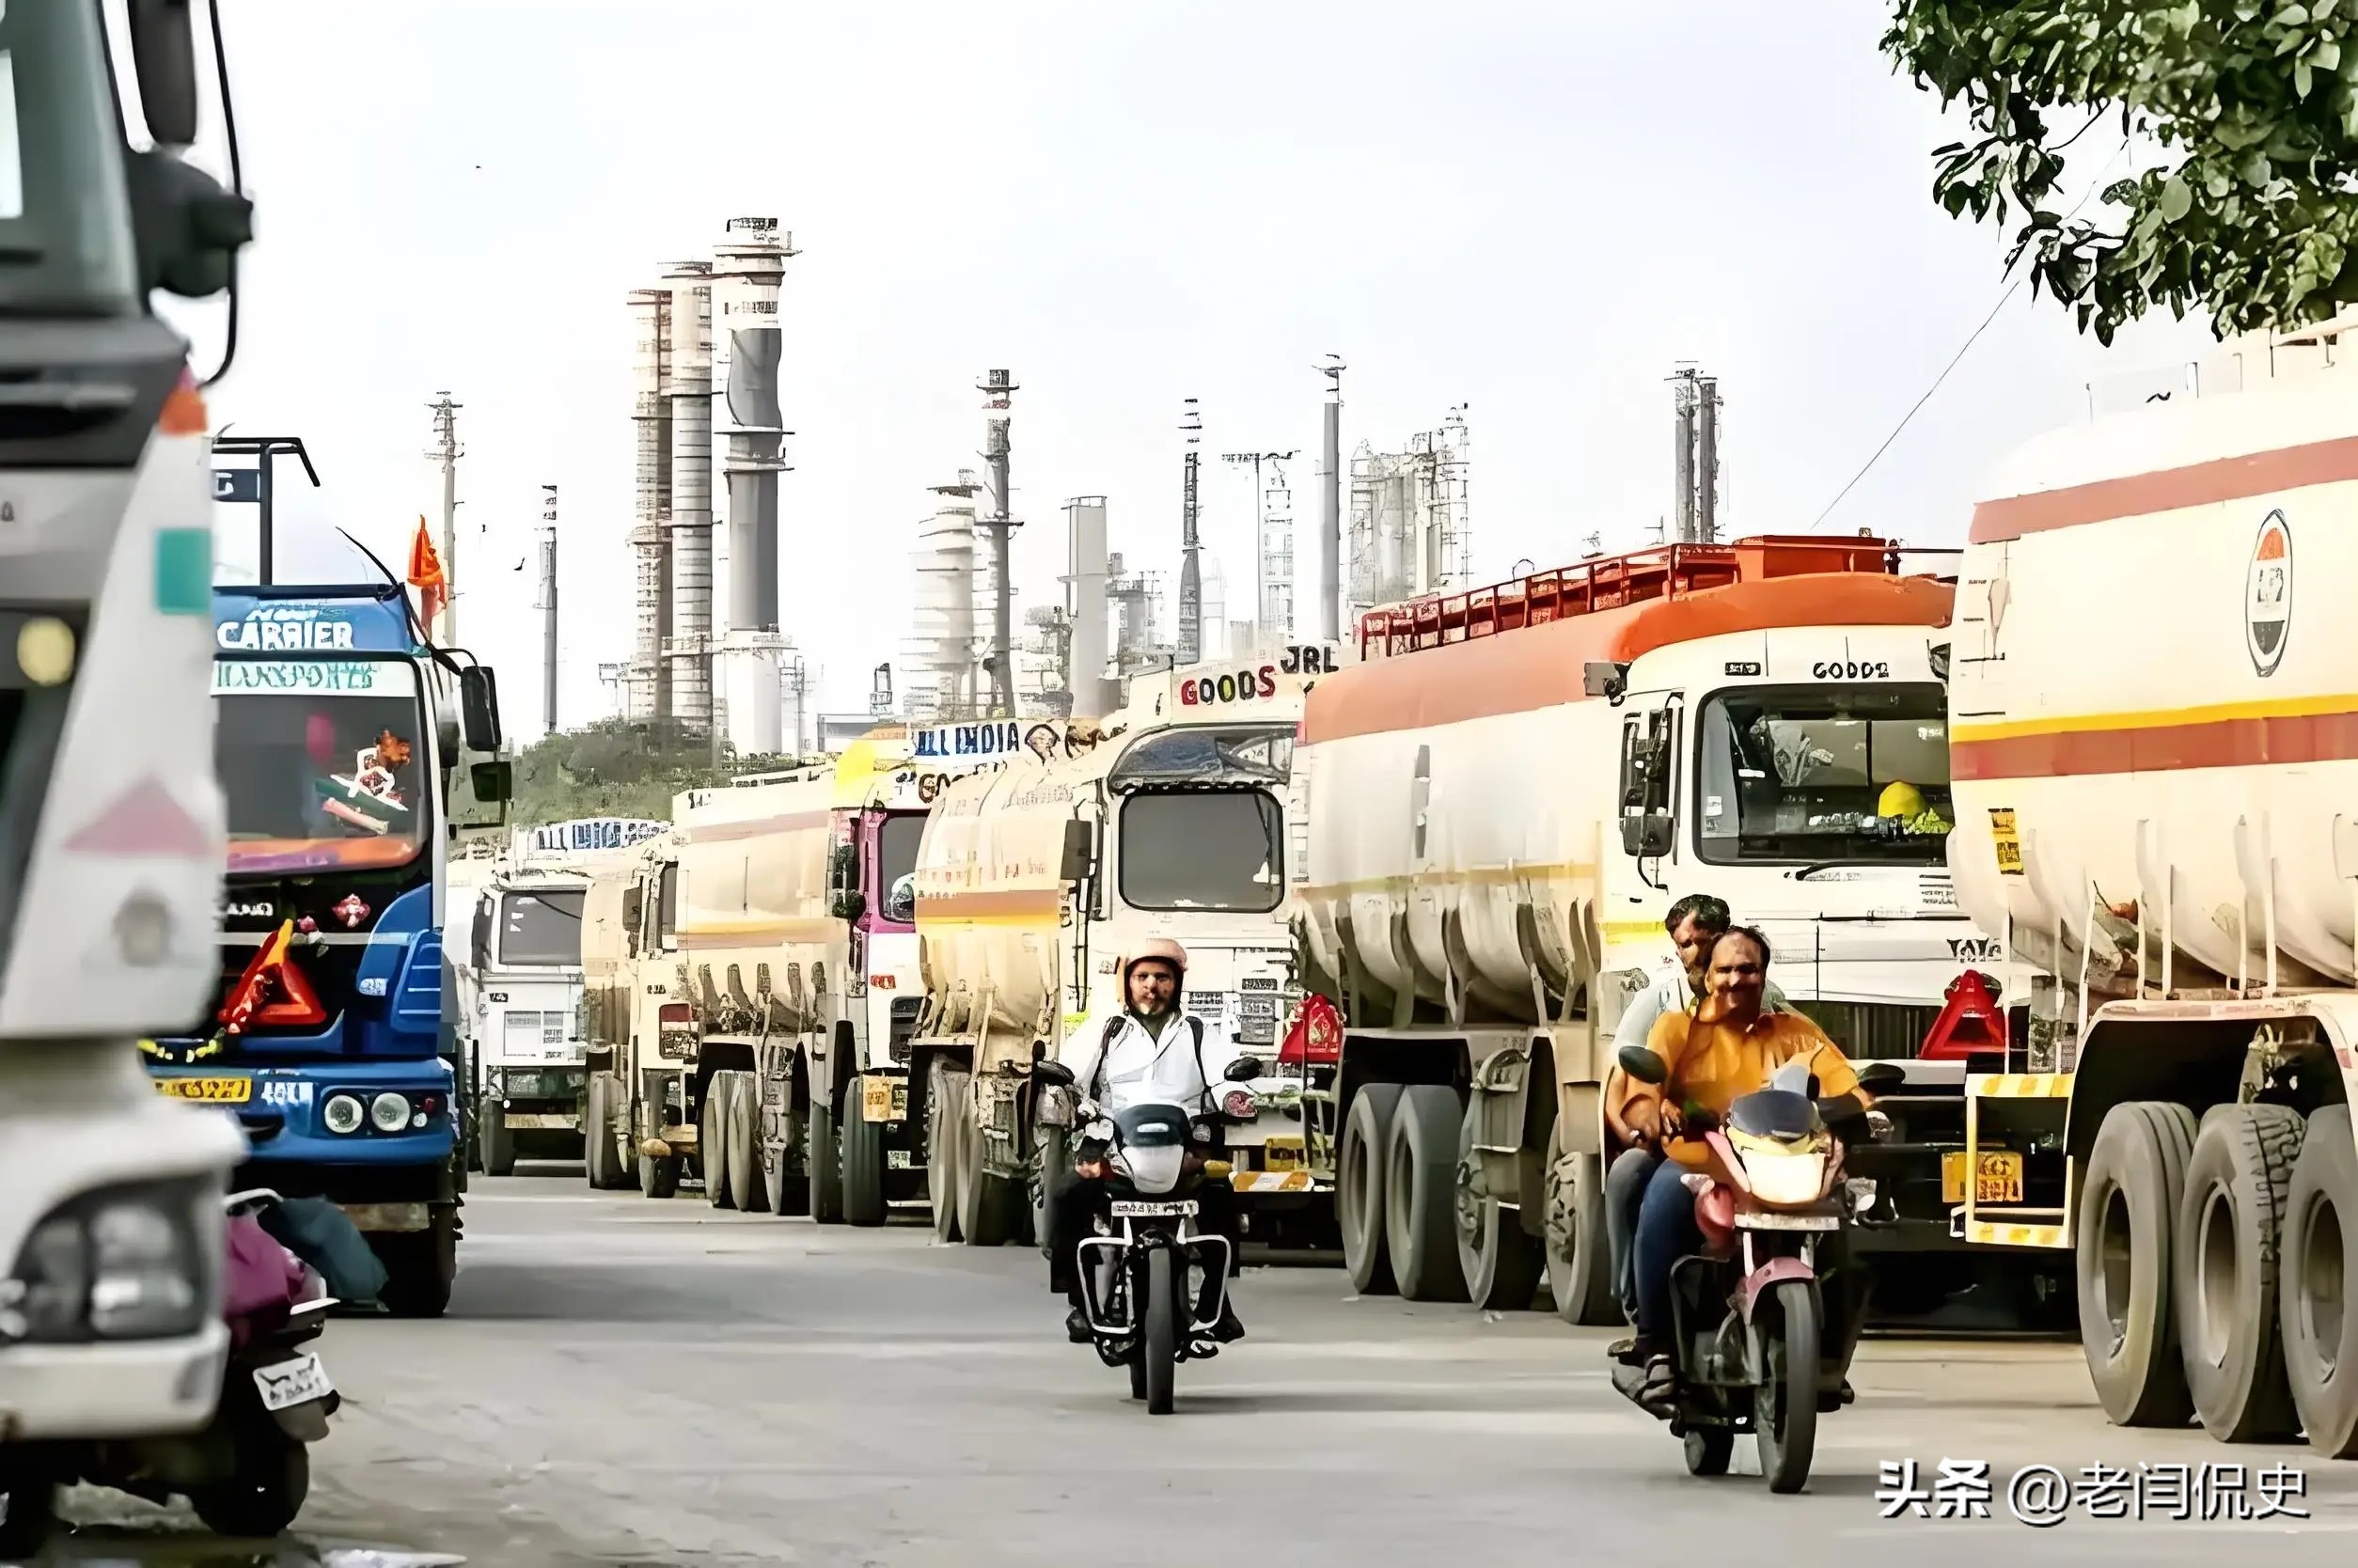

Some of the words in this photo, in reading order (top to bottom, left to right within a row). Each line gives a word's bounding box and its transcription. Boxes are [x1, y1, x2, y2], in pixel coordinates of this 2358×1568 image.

[216, 620, 354, 651] CARRIER
[1181, 665, 1277, 706] GOODS
[955, 722, 1020, 755] INDIA
